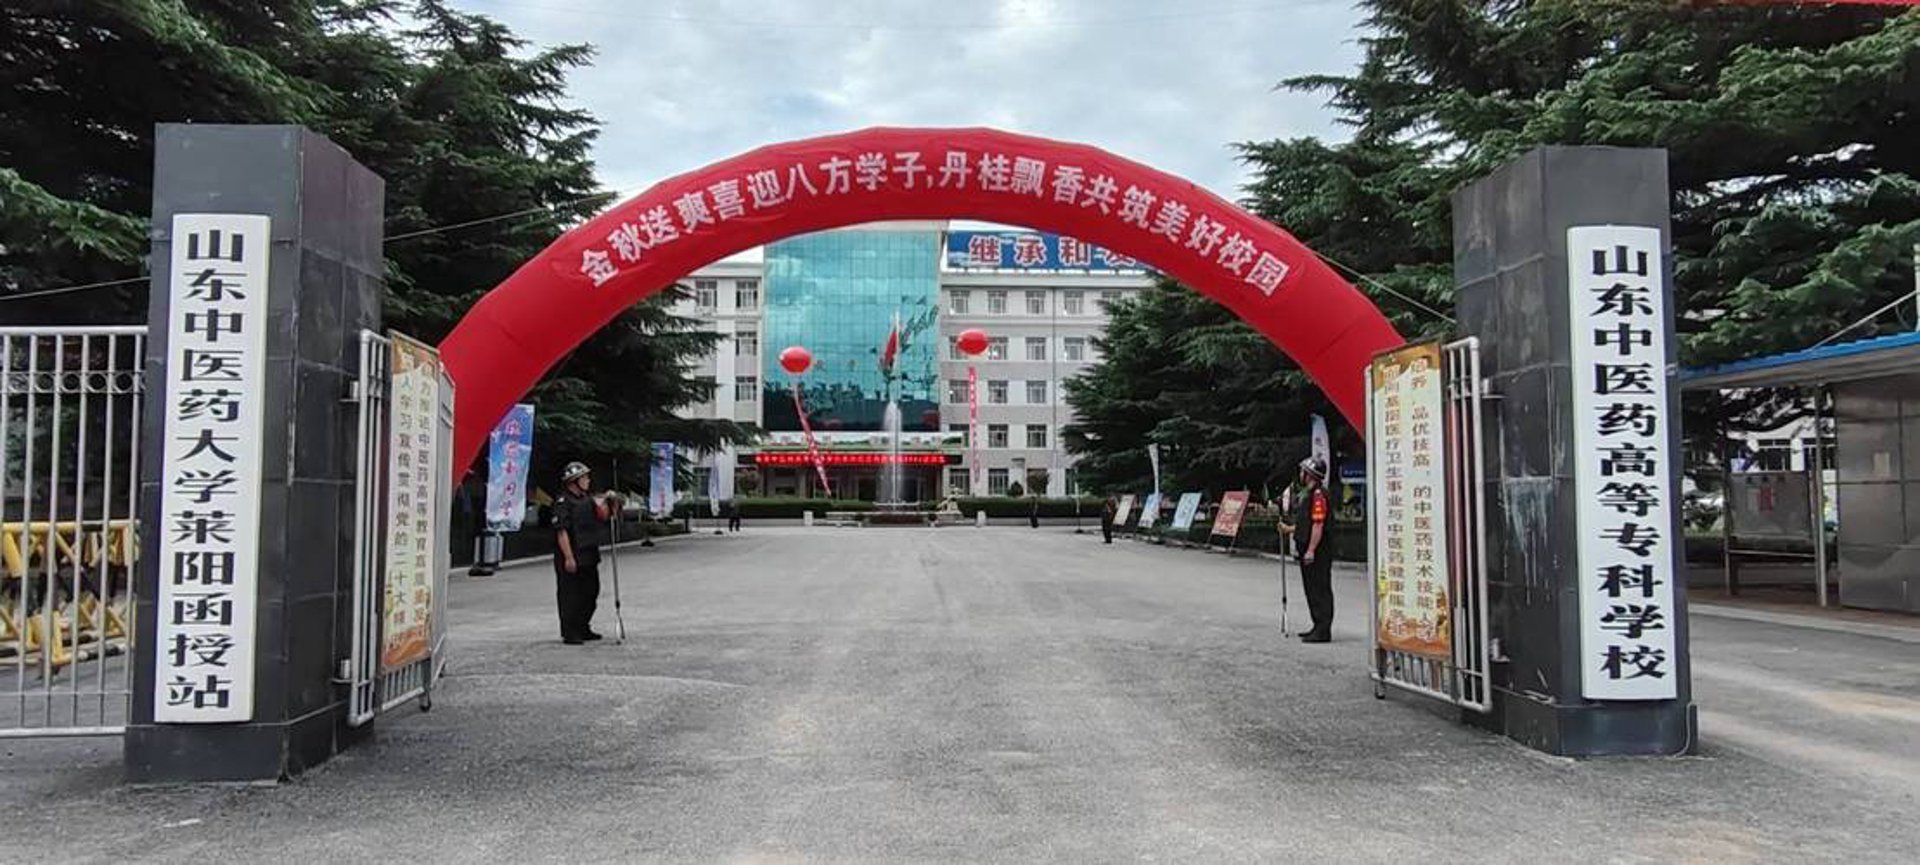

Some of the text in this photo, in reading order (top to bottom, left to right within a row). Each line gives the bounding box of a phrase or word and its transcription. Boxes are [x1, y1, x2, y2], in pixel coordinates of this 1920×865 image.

[166, 229, 247, 709] 山东中医药大学莱阳函授站
[1589, 245, 1667, 680] 山东中医药高等专科学校
